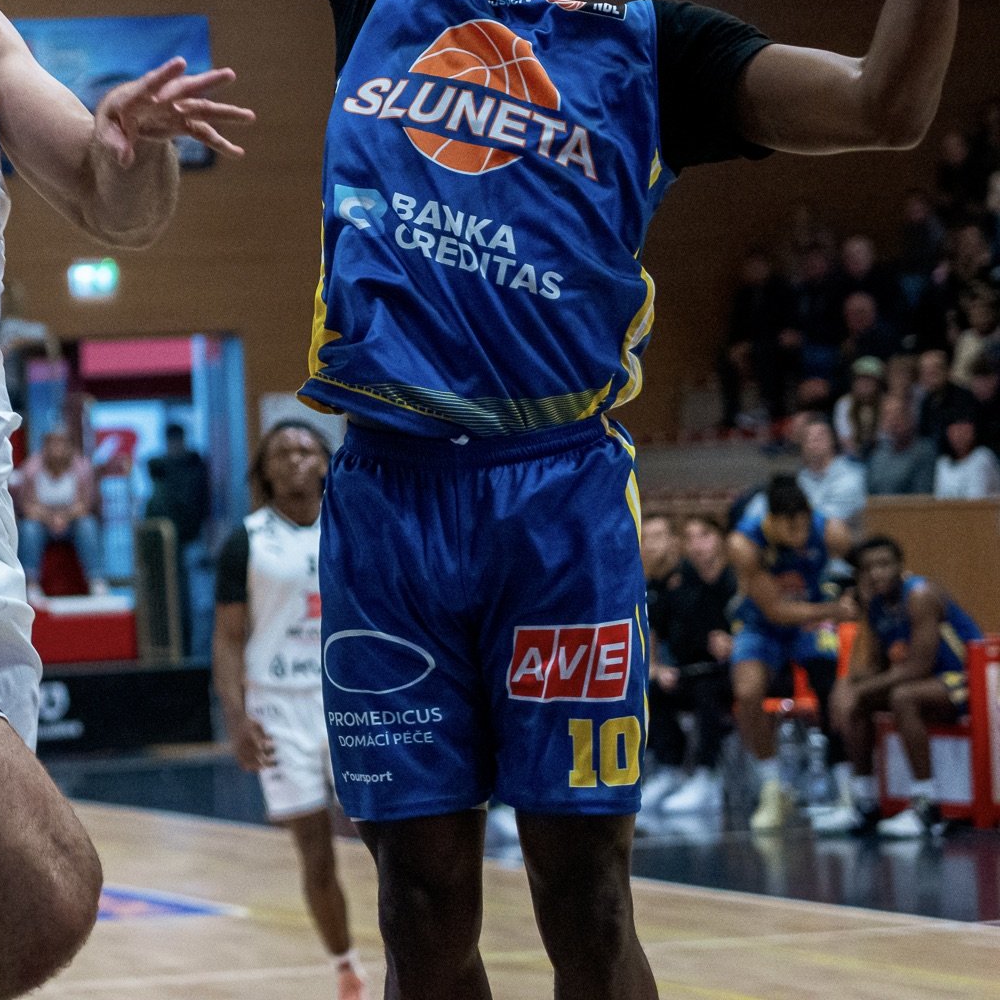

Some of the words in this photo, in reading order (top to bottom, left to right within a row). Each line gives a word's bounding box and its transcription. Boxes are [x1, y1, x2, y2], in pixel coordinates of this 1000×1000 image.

[343, 77, 599, 182] SLUNETA
[392, 192, 516, 255] BANKA
[395, 223, 564, 300] CREDITAS
[511, 642, 625, 682] AVE
[329, 707, 442, 726] PROMEDICUS
[339, 731, 390, 748] DOMÁCÍ
[392, 730, 434, 745] PÉČE
[568, 715, 641, 787] 10
